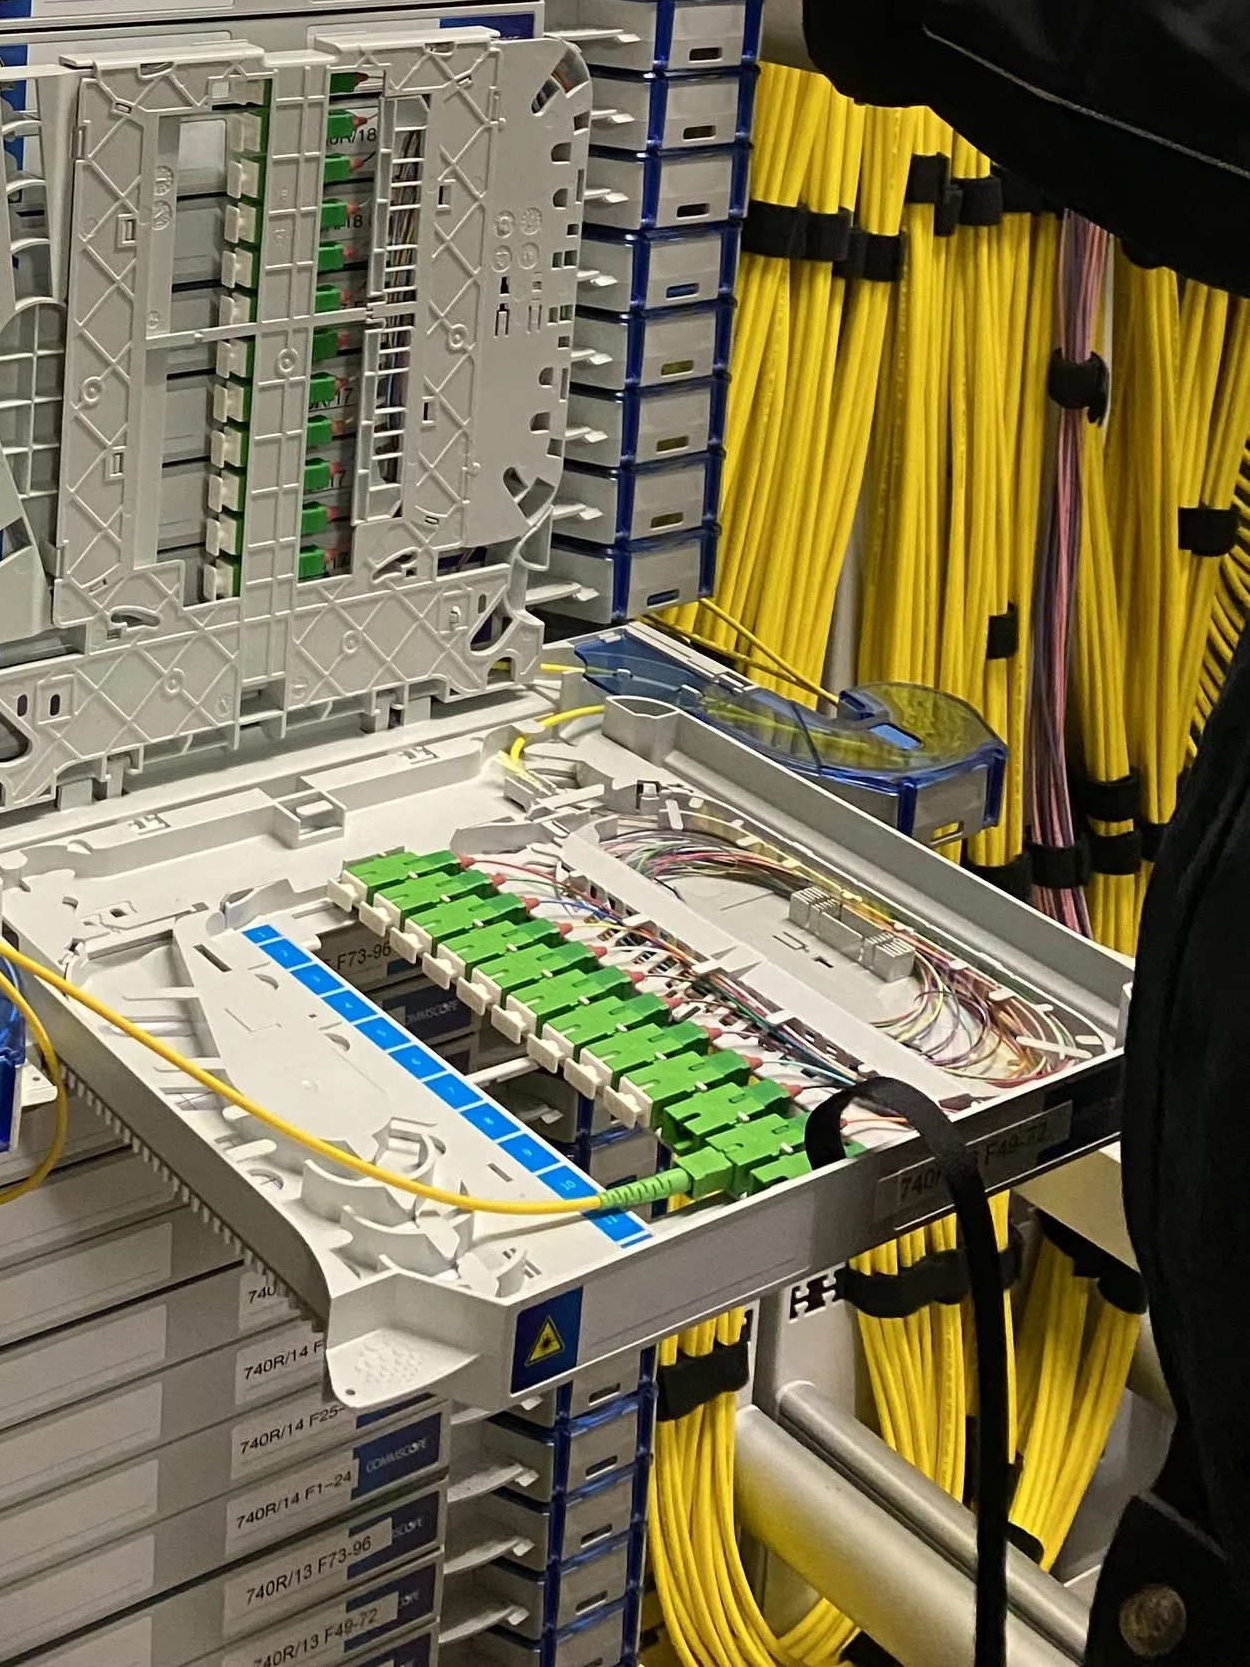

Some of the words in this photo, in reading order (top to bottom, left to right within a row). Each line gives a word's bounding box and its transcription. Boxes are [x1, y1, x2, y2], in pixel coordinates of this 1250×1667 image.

[560, 1180, 576, 1191] 10
[604, 1216, 618, 1225] 11
[245, 1346, 308, 1380] 740R/14
[240, 1418, 304, 1455] 740R/14
[237, 1492, 301, 1529] 740R/14
[305, 1470, 352, 1500] F1-24
[365, 1437, 427, 1474] COMMSCOPE
[246, 1565, 312, 1605] 740R/13
[317, 1535, 372, 1579] F73-96
[324, 1607, 378, 1644] F49-72
